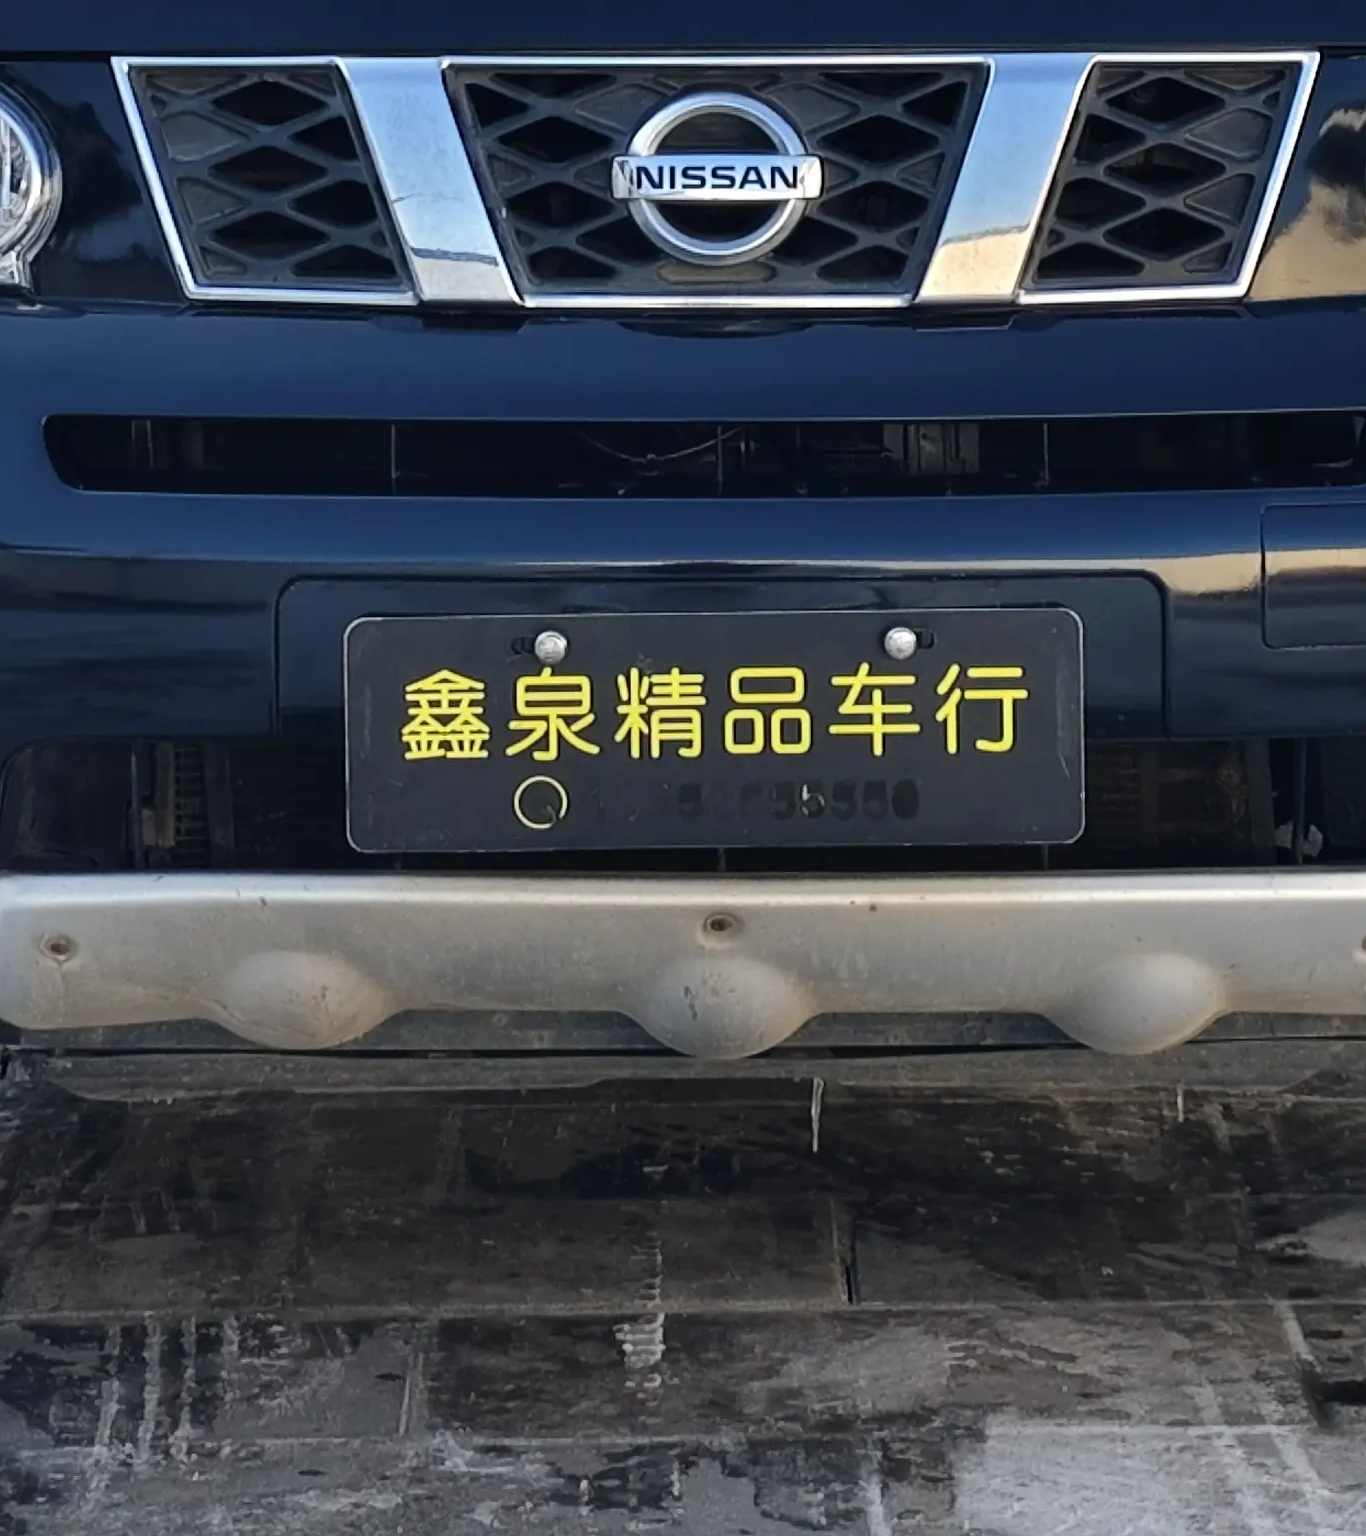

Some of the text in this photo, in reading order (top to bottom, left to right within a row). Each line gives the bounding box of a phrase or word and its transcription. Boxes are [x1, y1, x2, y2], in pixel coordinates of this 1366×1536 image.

[635, 165, 799, 190] NISSAN
[401, 663, 1028, 761] 鑫泉精品车行
